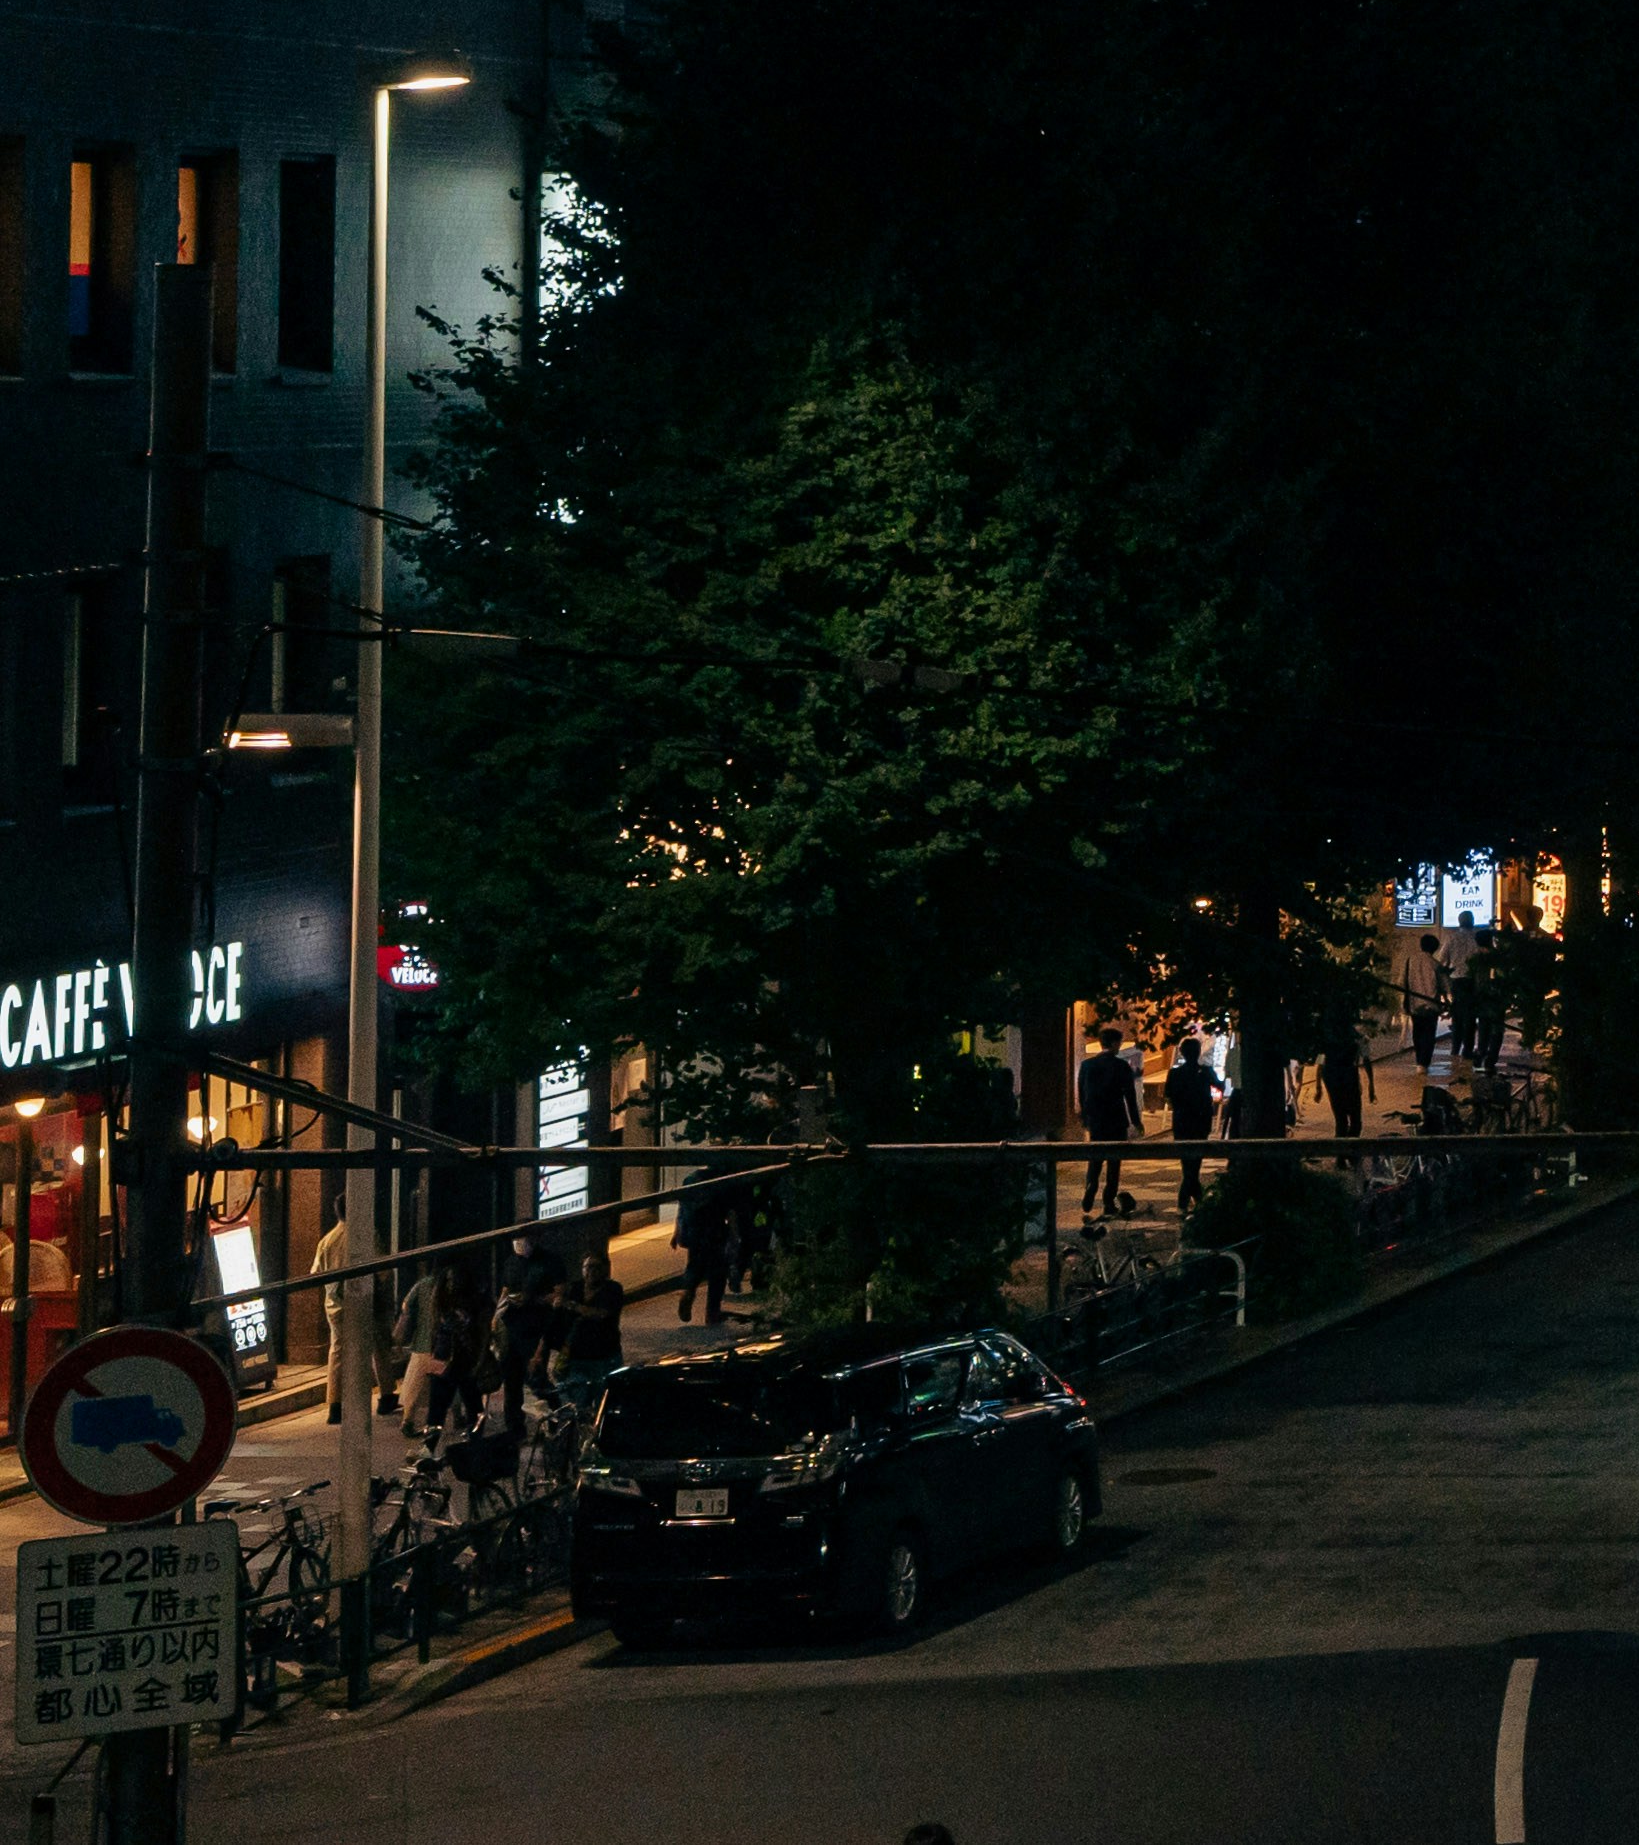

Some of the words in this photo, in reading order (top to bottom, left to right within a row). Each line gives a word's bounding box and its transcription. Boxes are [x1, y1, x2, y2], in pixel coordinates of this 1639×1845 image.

[1454, 899, 1484, 910] DRINK
[391, 966, 438, 985] VELOCE
[35, 1544, 220, 1592] 土曜22時から
[35, 1595, 96, 1635] 日曜
[123, 1589, 221, 1626] 7時まで
[34, 1625, 220, 1678] 環七通り以内
[34, 1669, 219, 1724] 都心全域
